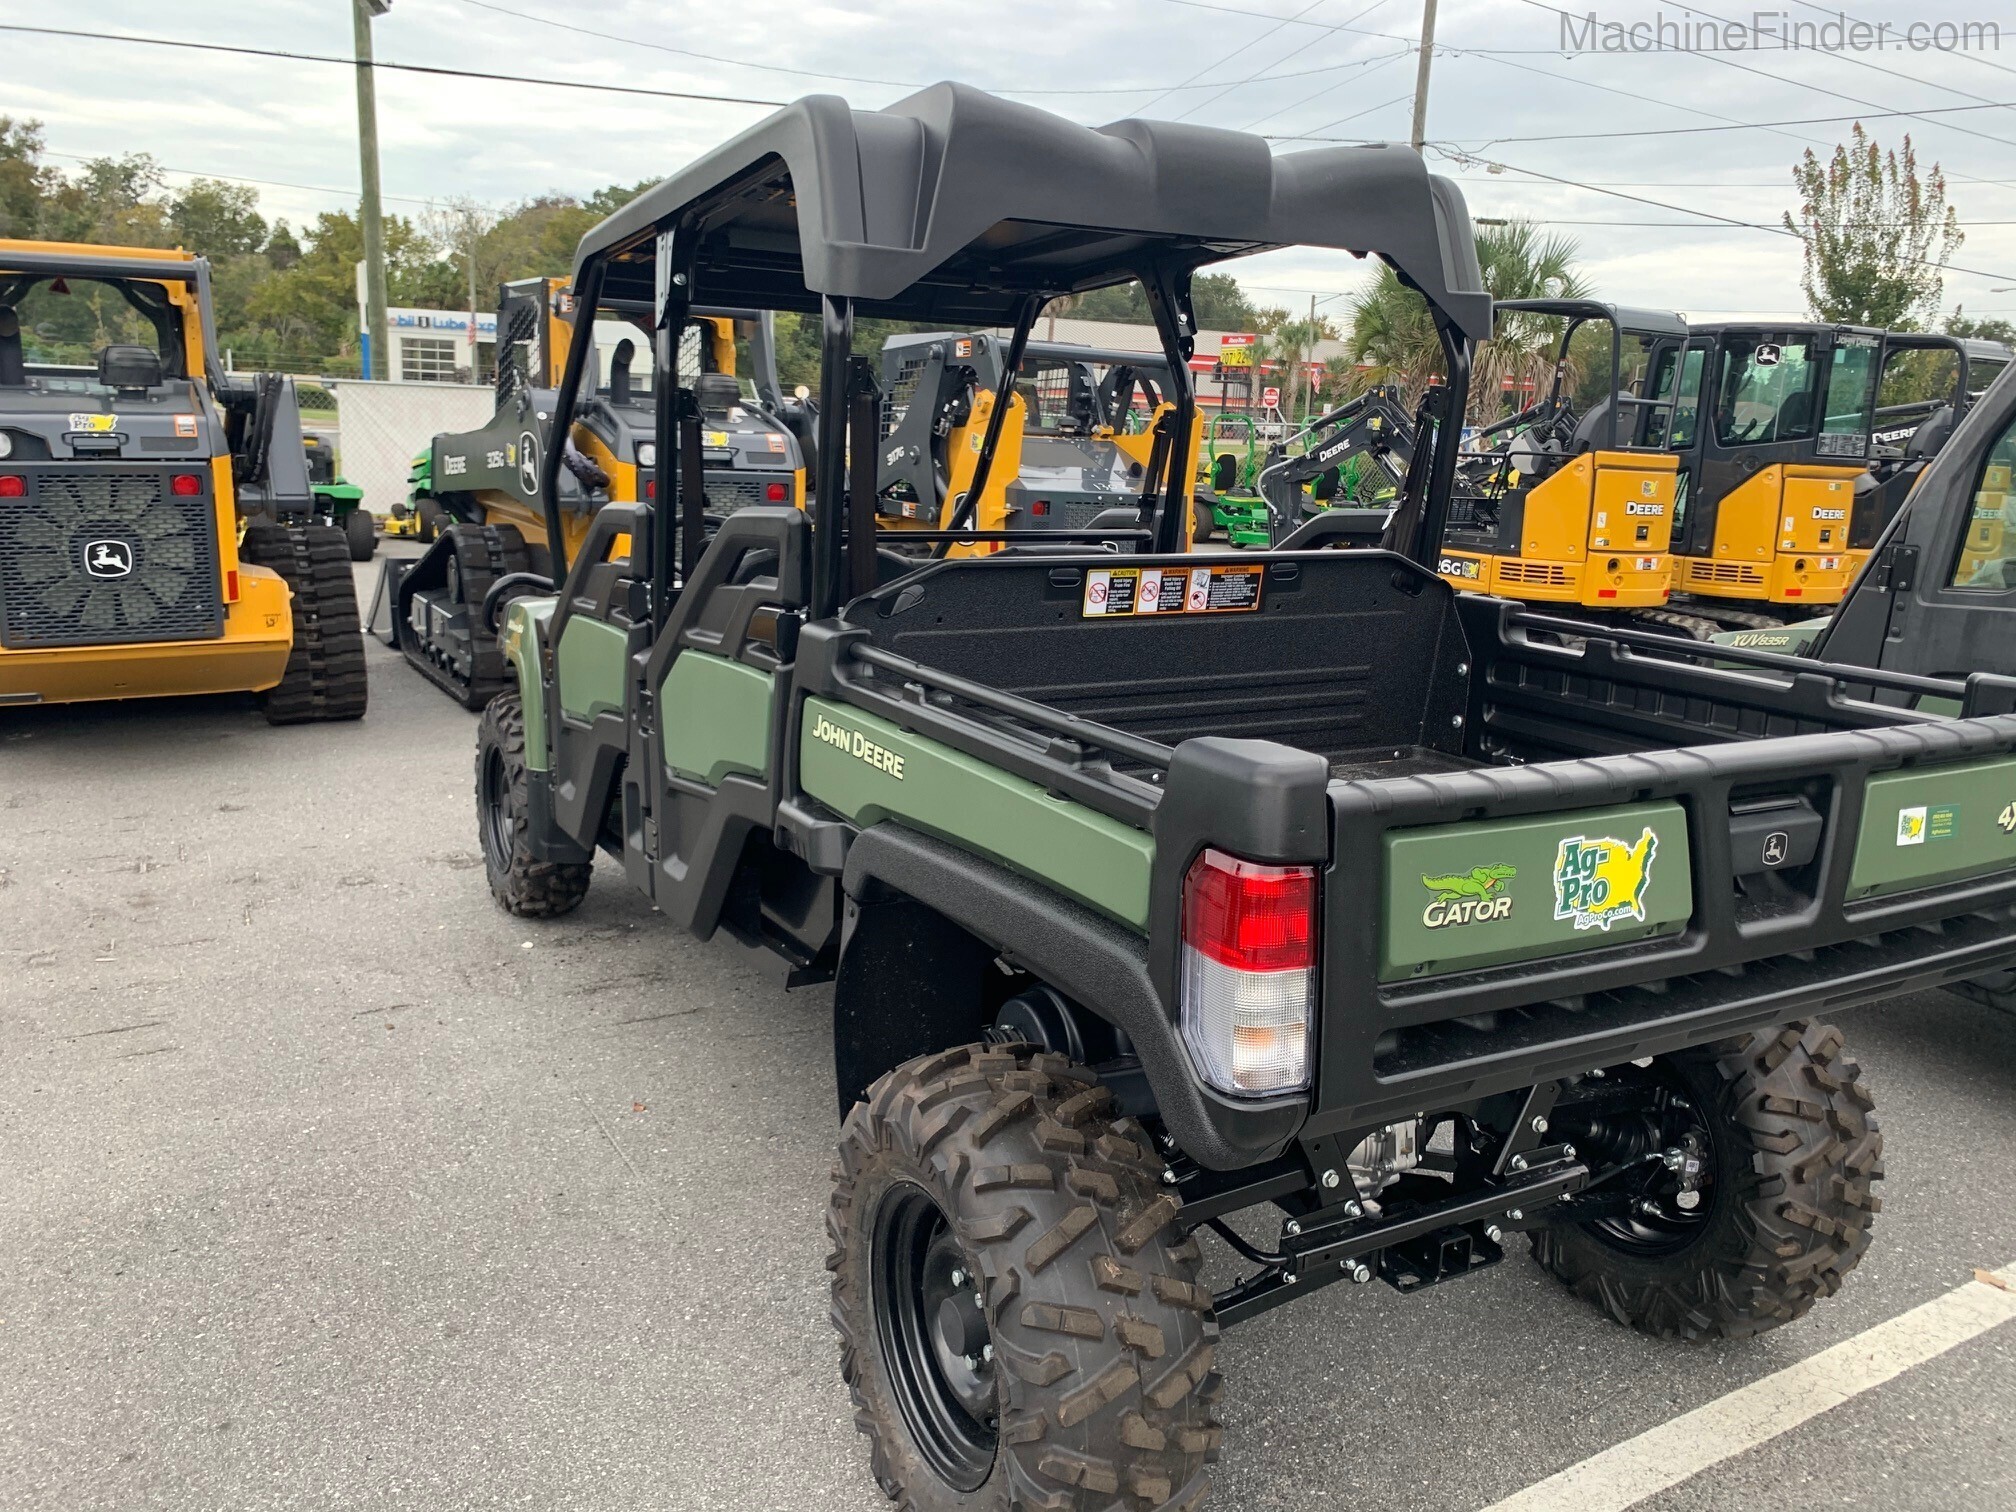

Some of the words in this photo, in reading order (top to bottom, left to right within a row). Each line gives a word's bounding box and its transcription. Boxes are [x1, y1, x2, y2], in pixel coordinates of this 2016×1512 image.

[1319, 438, 1350, 462] DEERE
[444, 454, 467, 475] DEERE
[1626, 501, 1664, 516] DEERE
[1811, 506, 1846, 520] DEERE
[812, 713, 851, 753] JOHN
[852, 730, 905, 780] DEERE
[1559, 842, 1609, 881] Ag-
[1559, 877, 1609, 914] Pro
[1422, 897, 1513, 930] GATOR
[1577, 906, 1632, 926] AgProCo.com
